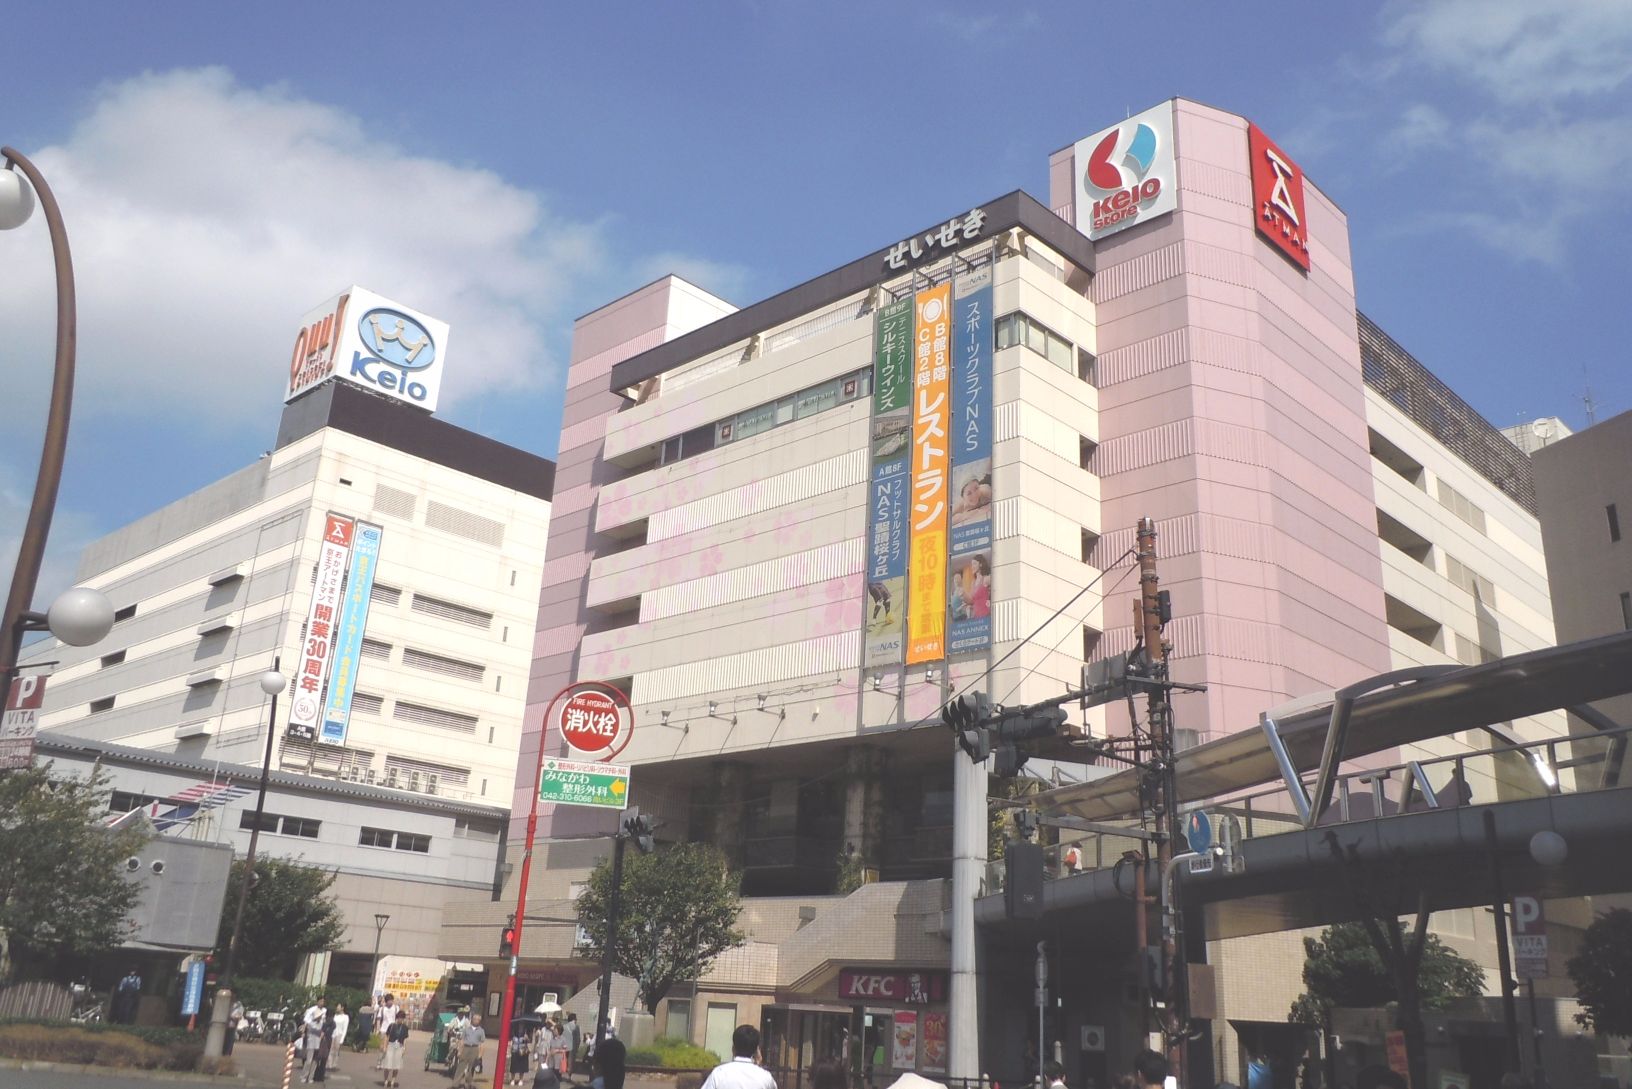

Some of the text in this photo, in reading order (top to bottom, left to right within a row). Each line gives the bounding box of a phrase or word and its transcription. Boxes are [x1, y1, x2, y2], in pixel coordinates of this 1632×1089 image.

[884, 208, 987, 270] せいせき
[897, 316, 907, 385] テニススクール
[917, 328, 931, 389] C館2階
[932, 322, 947, 383] B館8階
[350, 350, 428, 402] Keio
[963, 301, 981, 452] スポーツクラブNAS
[914, 388, 945, 531] レストラン
[892, 479, 903, 562] フットサルクラブ
[300, 603, 333, 694] 開業30周年
[880, 640, 900, 650] NAS
[16, 675, 38, 708] P
[573, 698, 613, 709] FIRE HYDRANT
[8, 711, 34, 725] VITA
[565, 708, 617, 736] 消火栓
[544, 770, 590, 785] みなかわ
[562, 783, 608, 797] 整形外科
[1515, 896, 1540, 933] P
[1516, 936, 1544, 947] VITA
[849, 974, 895, 996] KFC
